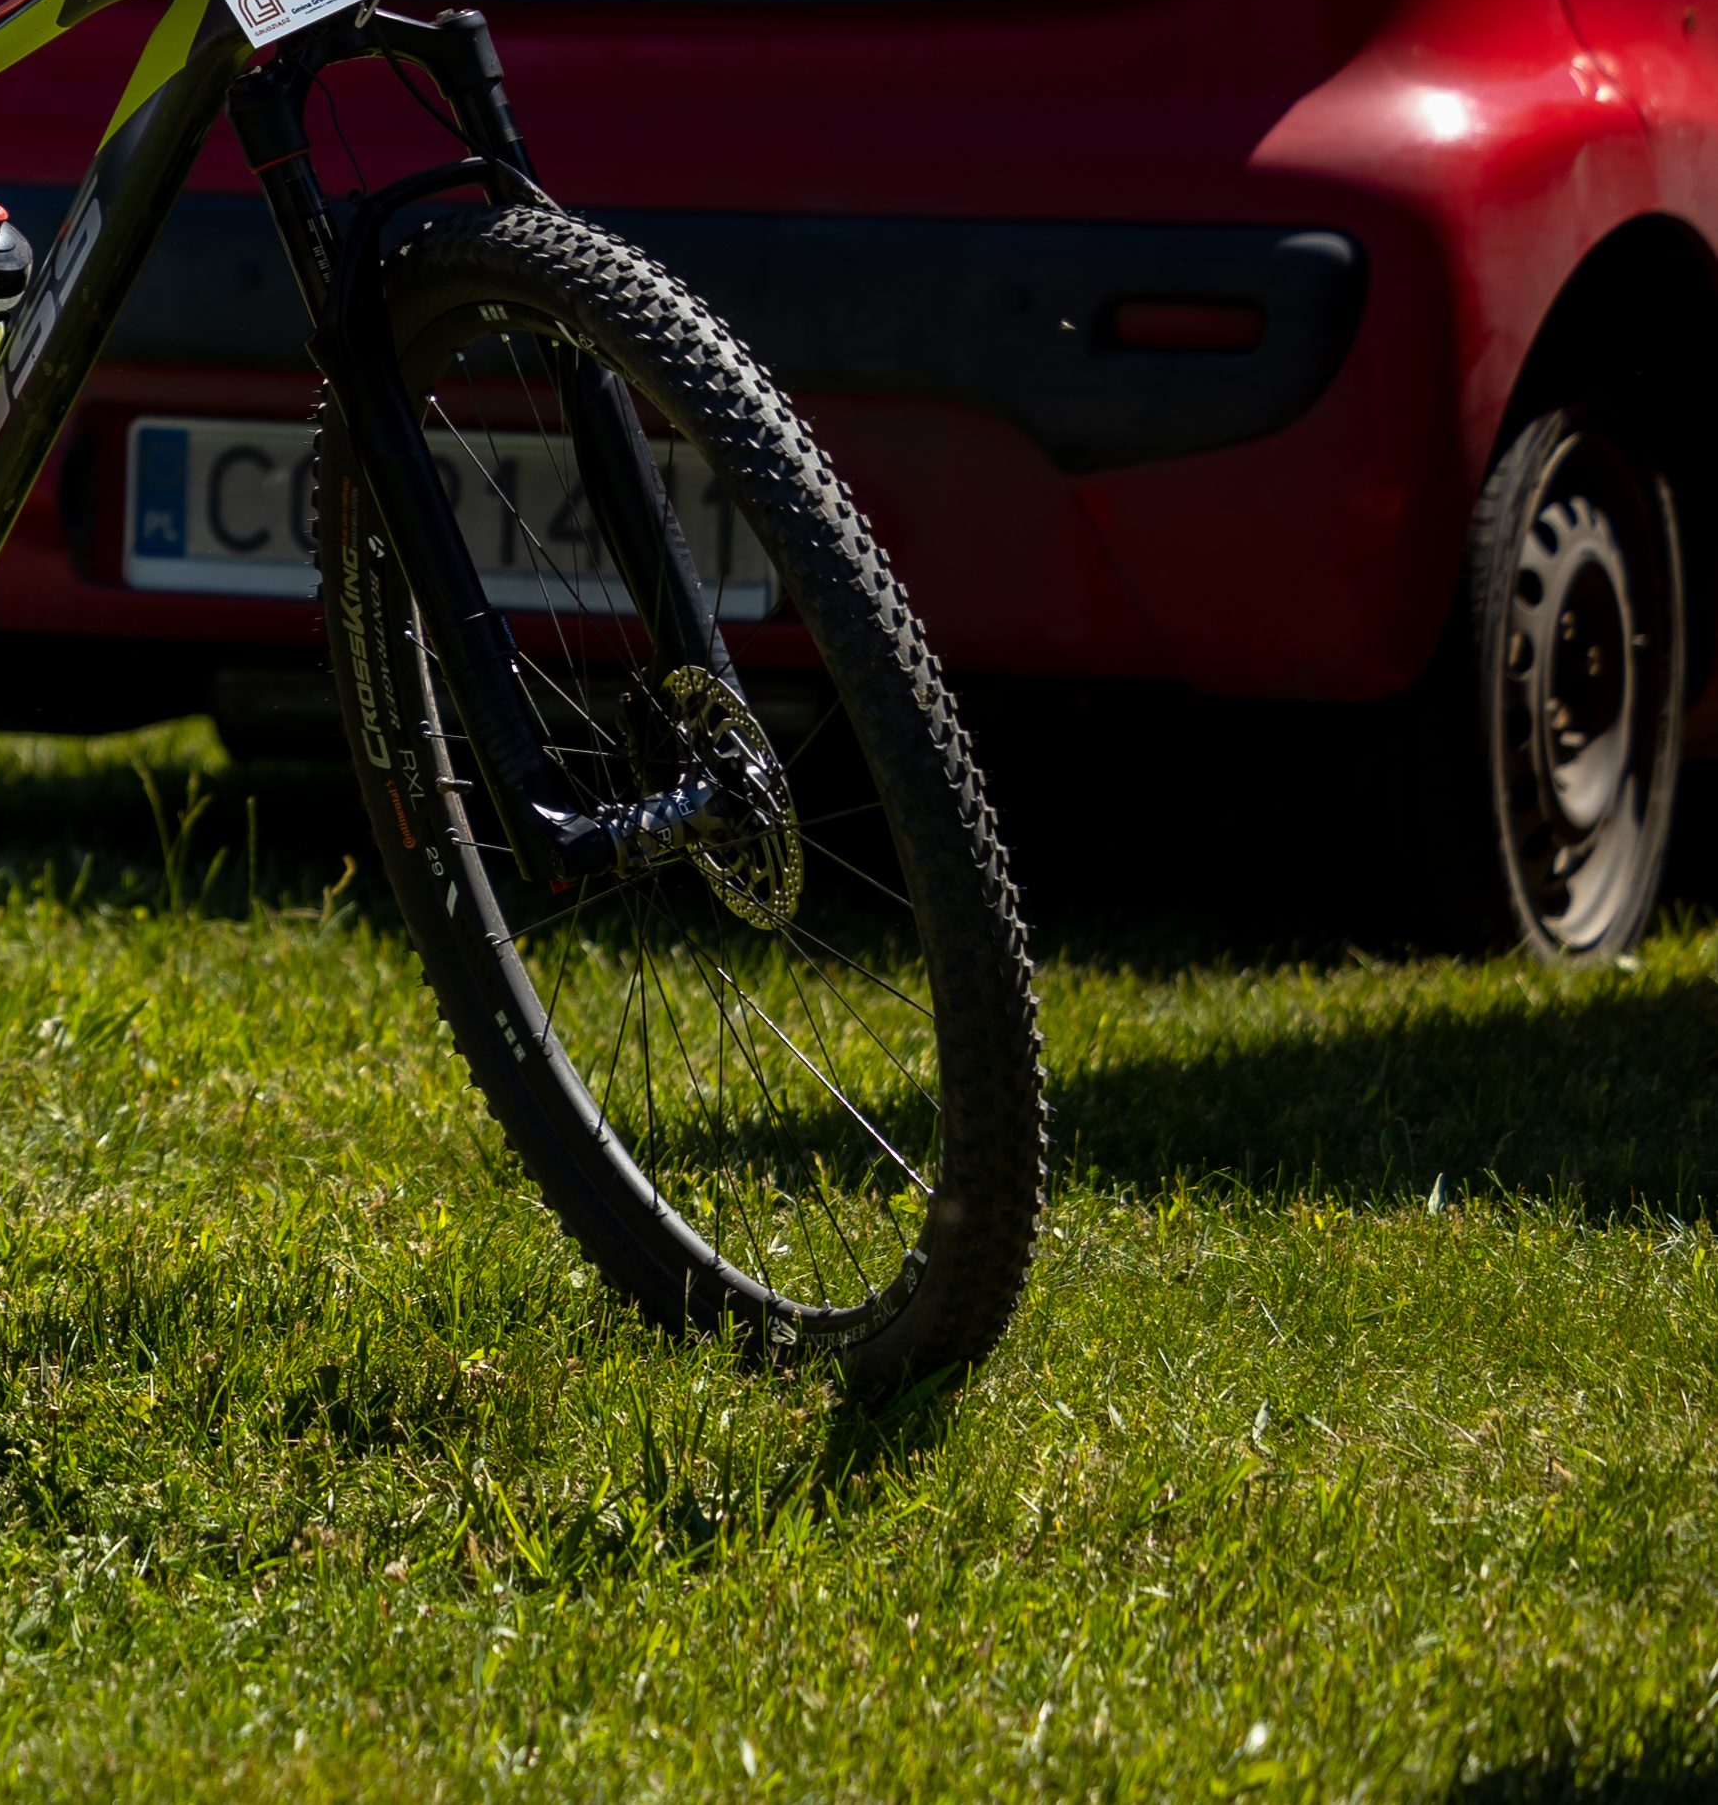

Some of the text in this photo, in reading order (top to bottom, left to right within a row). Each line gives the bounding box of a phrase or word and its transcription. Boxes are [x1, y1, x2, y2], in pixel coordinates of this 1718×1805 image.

[366, 566, 402, 732] BONTRAGER
[397, 747, 428, 813] RXL
[423, 844, 446, 879] 29
[799, 1322, 868, 1347] ONTRAGER
